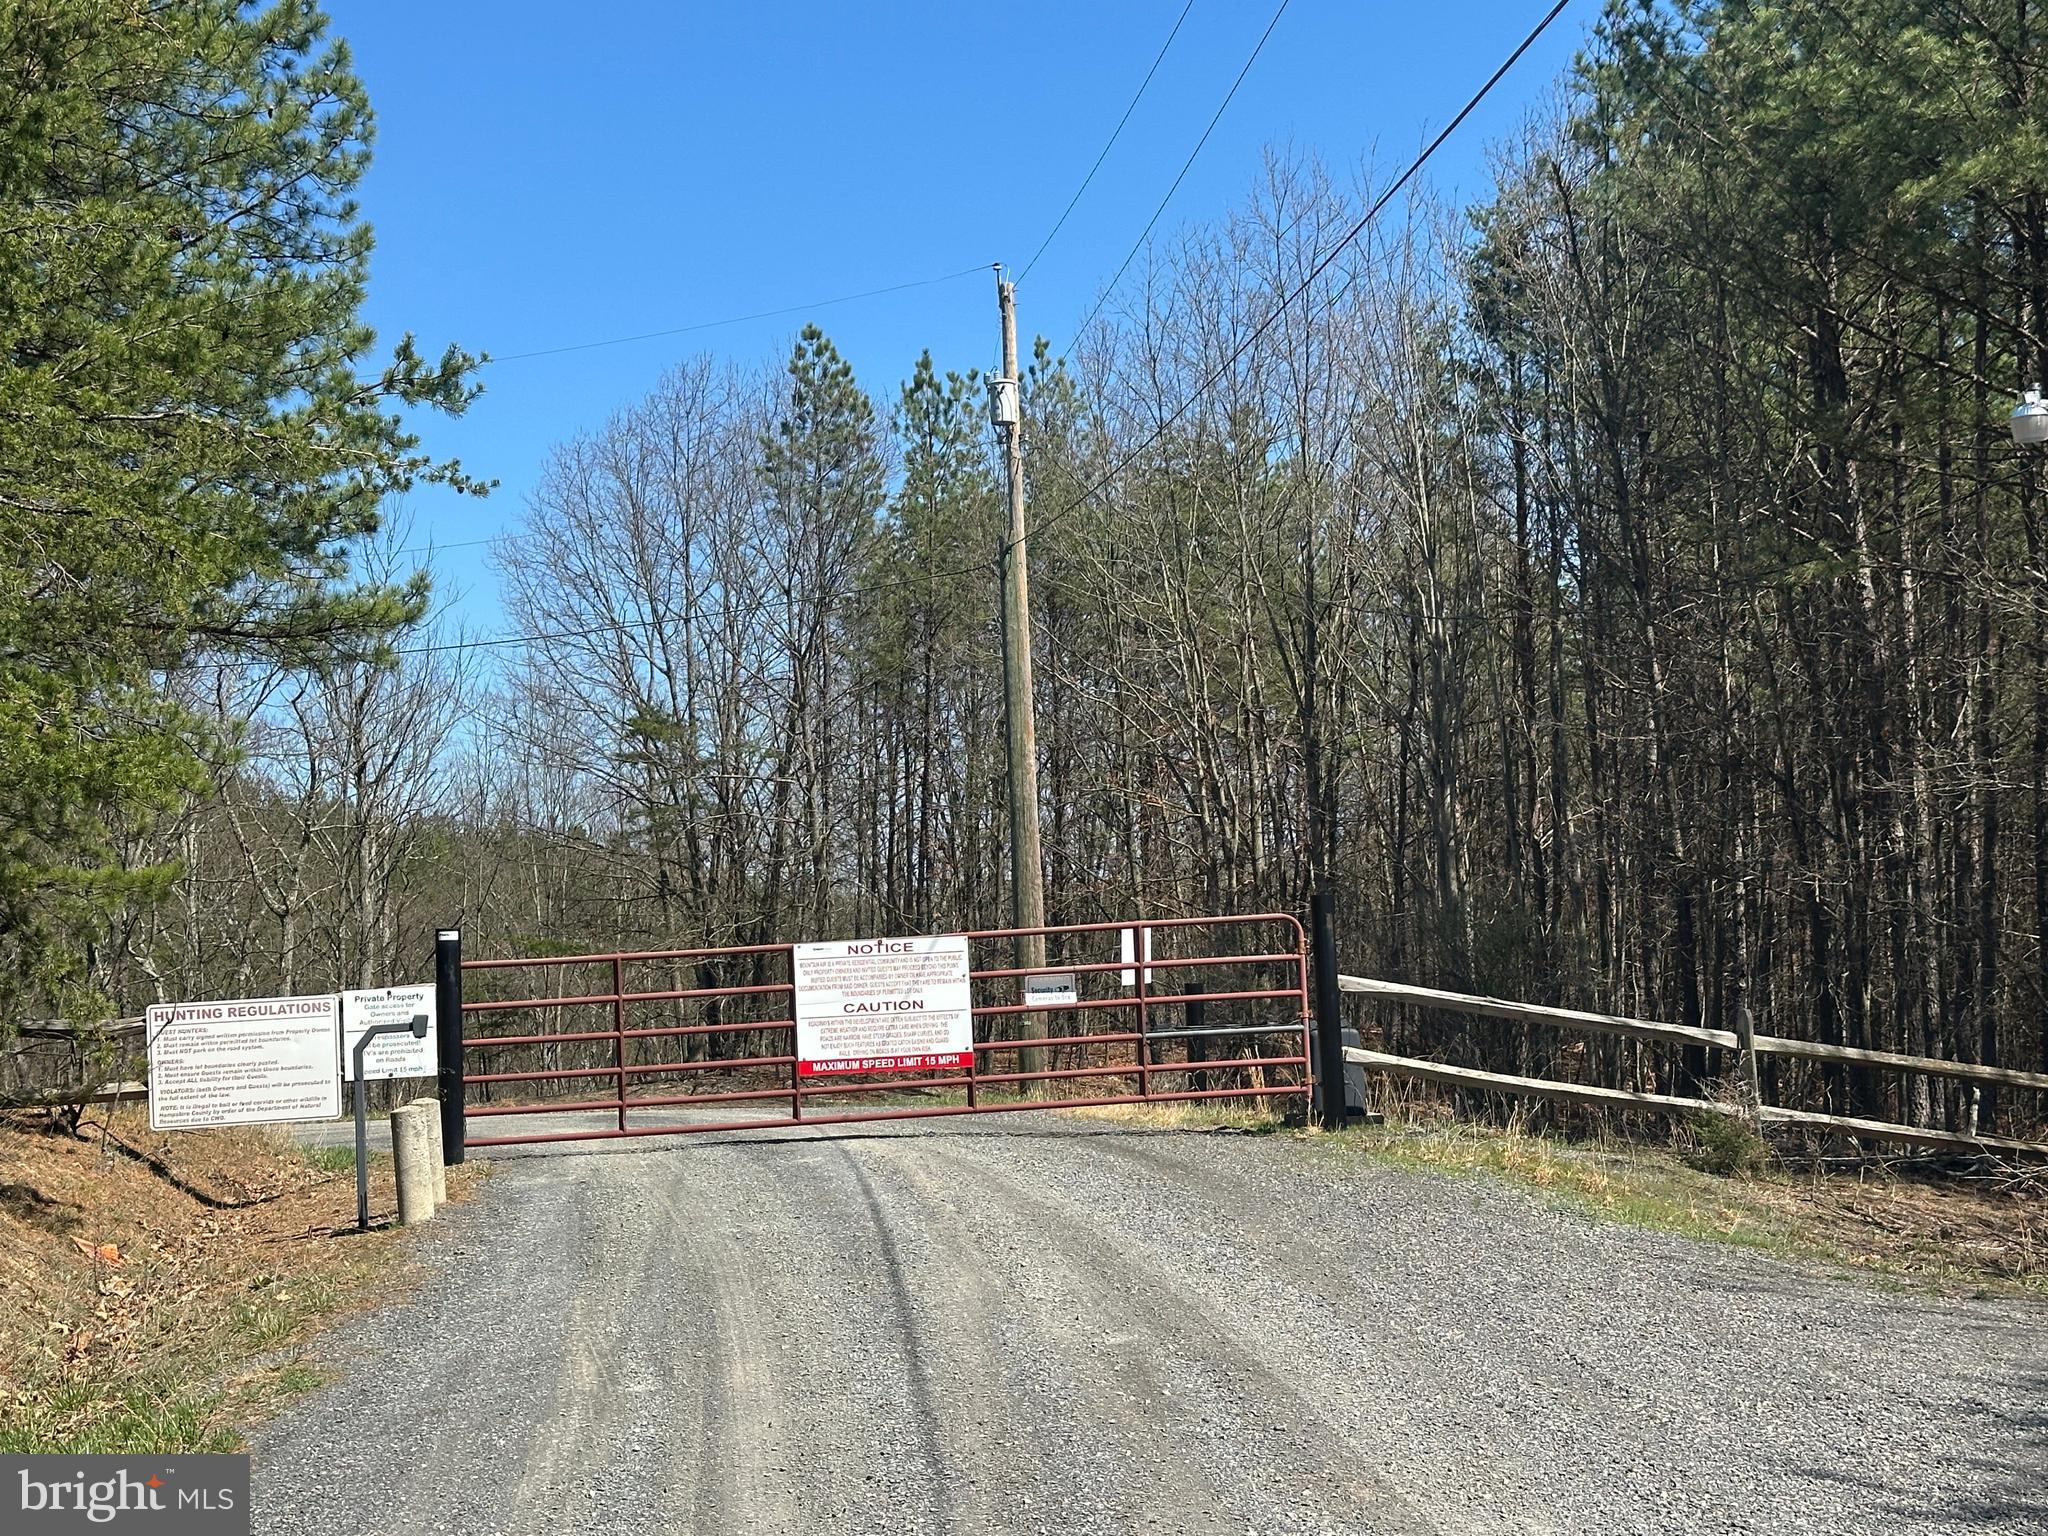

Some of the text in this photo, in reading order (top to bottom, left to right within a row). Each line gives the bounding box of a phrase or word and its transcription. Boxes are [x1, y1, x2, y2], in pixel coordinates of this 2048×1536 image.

[848, 942, 914, 955] NOTICE
[354, 993, 424, 1004] Private Property
[154, 1002, 331, 1022] HUNTING REGULATIONS
[844, 1000, 923, 1013] CAUTION
[813, 1055, 960, 1071] MAXIMUM SPEED LIMIT 15 MPH
